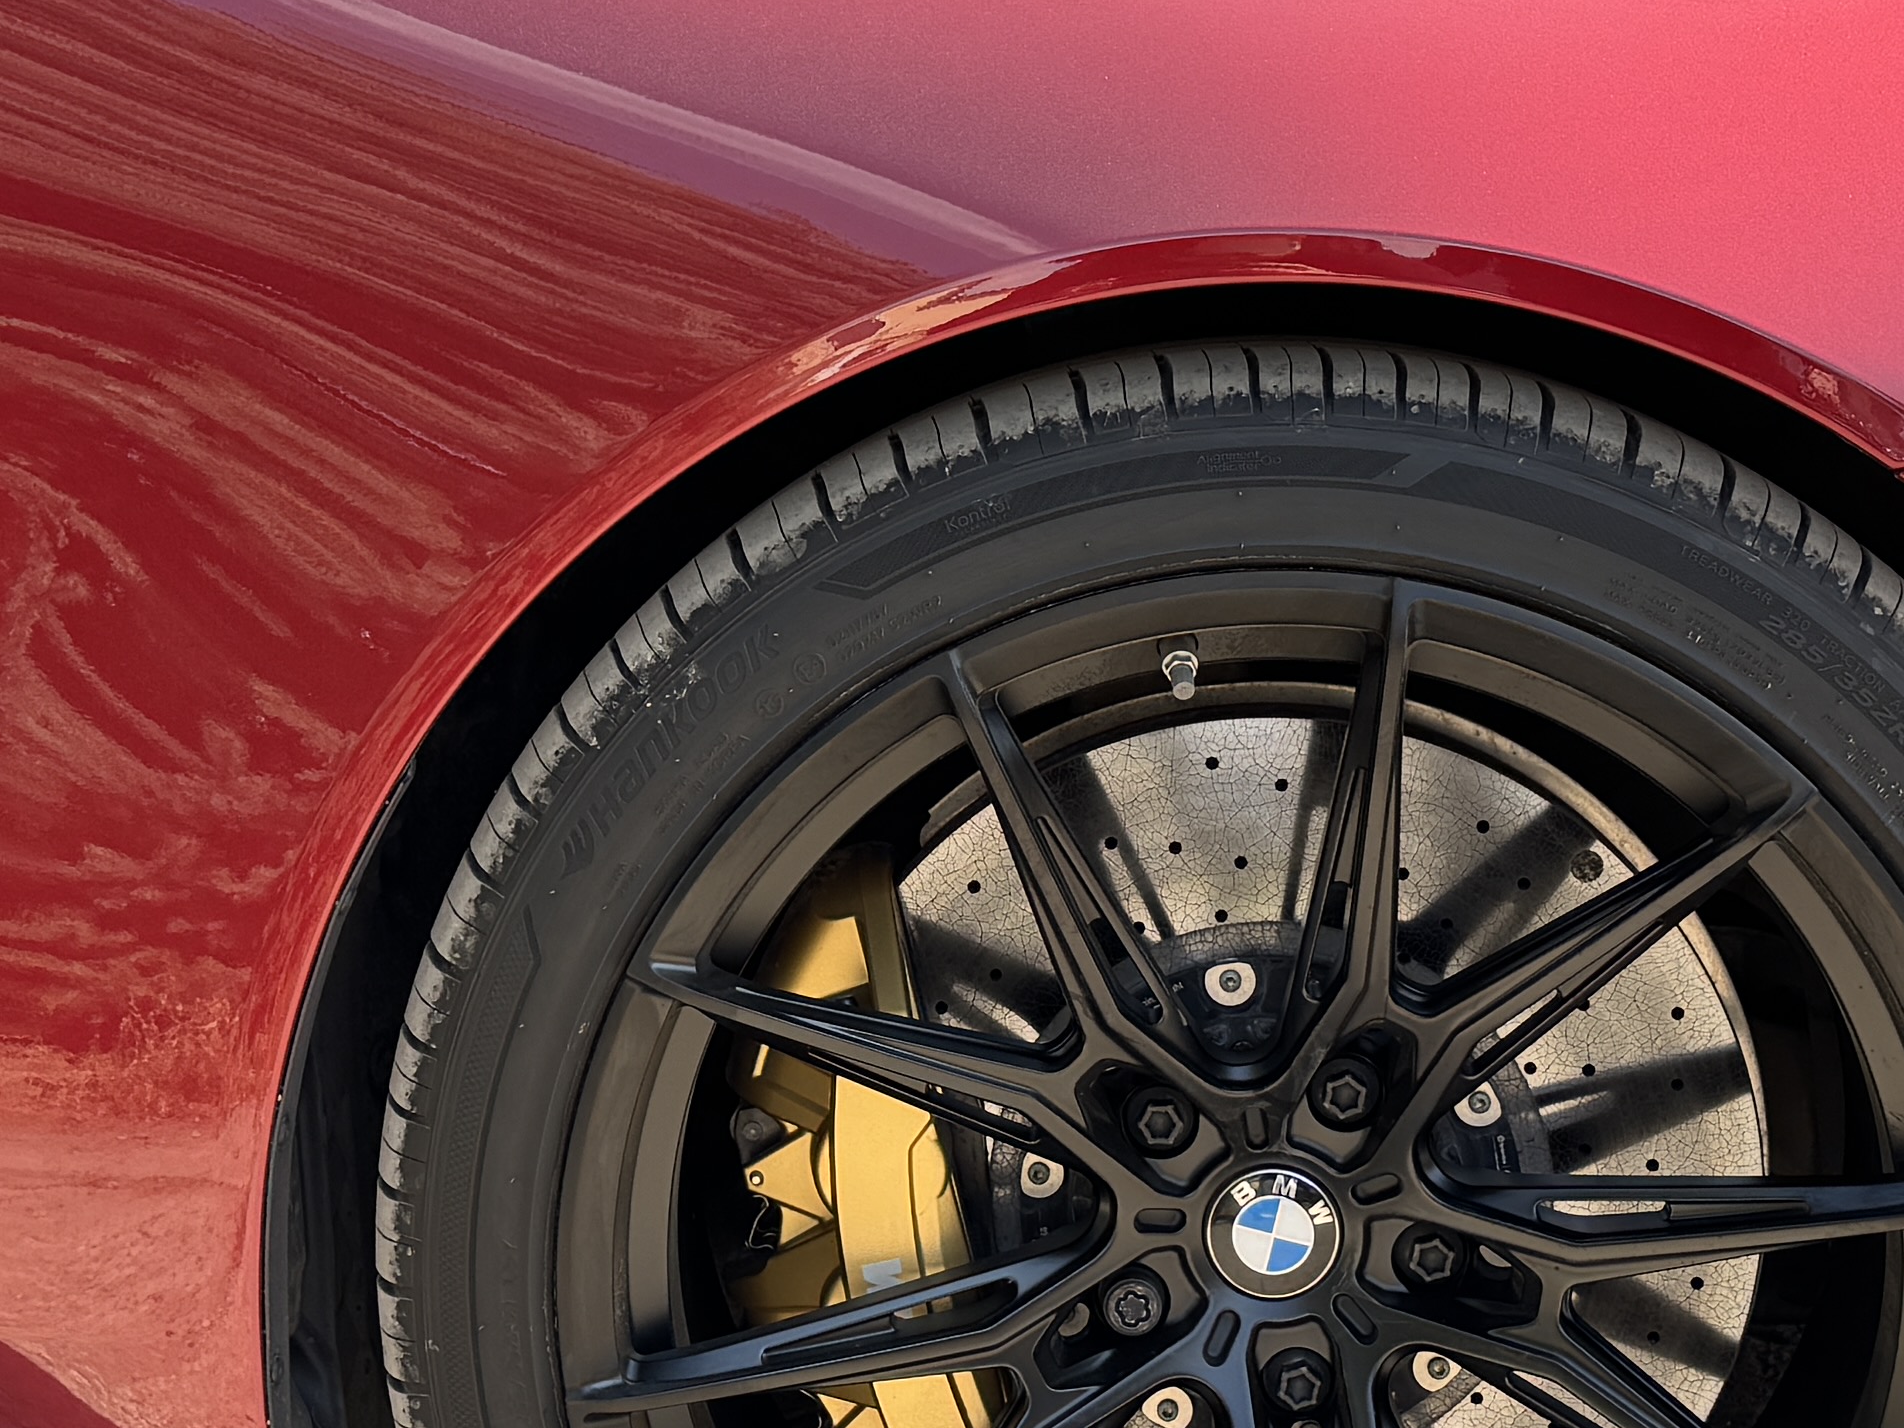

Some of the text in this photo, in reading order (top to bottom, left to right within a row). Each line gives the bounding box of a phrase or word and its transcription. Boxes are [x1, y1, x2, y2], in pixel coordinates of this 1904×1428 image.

[942, 496, 1011, 534] Kontrol
[1676, 542, 1775, 607] TREADWEAR
[1779, 605, 1813, 633] 320
[1817, 633, 1887, 695] TRACTION
[579, 620, 789, 838] Hankook
[1230, 1174, 1334, 1226] BMW
